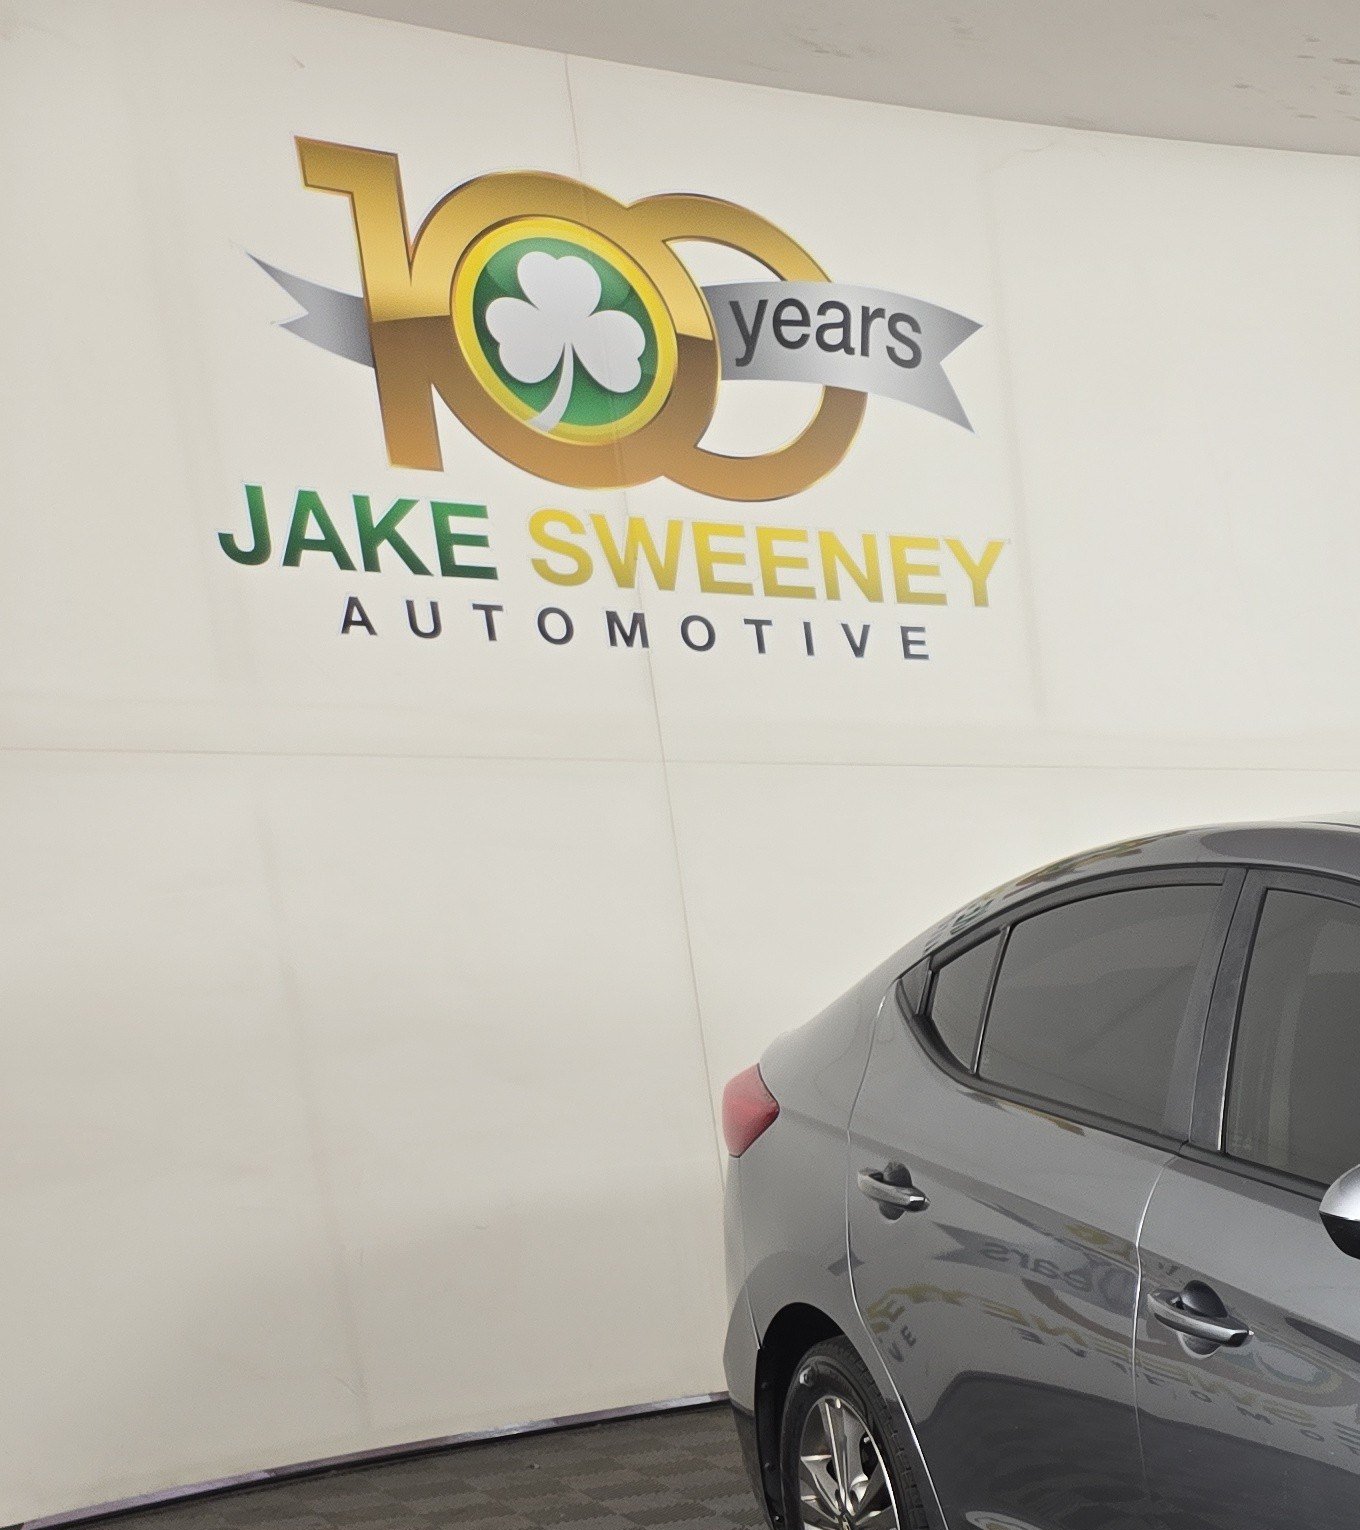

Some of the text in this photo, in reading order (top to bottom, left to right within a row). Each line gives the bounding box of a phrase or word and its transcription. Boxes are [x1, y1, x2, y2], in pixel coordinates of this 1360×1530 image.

[728, 294, 922, 369] years
[218, 484, 1004, 607] JAKE SWEENEY
[341, 597, 930, 660] AUTOMOTIVE
